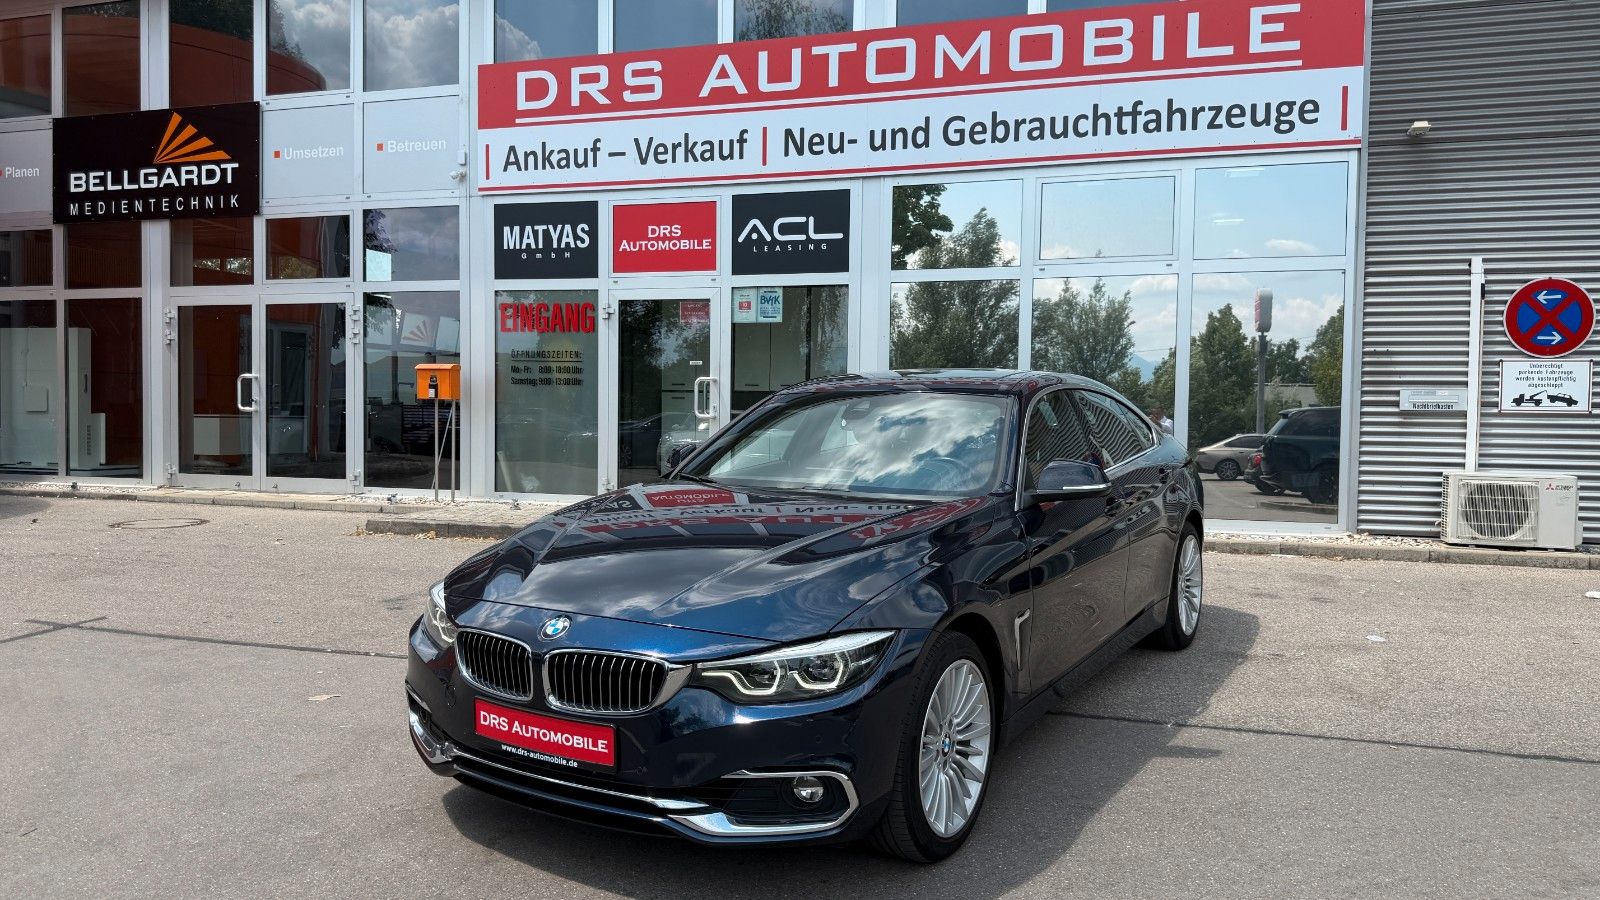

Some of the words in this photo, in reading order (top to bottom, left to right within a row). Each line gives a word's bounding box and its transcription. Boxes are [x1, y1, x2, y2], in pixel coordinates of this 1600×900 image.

[516, 60, 663, 111] DRS
[699, 3, 1301, 98] AUTOMOBILE
[387, 138, 447, 153] Betreuen
[502, 138, 601, 173] Ankauf
[634, 129, 748, 166] Verkauf
[783, 127, 858, 158] Neu-
[869, 116, 930, 152] und
[942, 98, 1320, 147] Gebrauchtfahrzeuge
[284, 145, 344, 160] Umsetzen
[5, 166, 40, 178] Planen
[70, 163, 239, 193] BELLGARDT
[70, 194, 239, 216] MEDIENTECHNIK
[503, 223, 590, 250] MATYAS
[647, 225, 682, 238] DRS
[737, 216, 844, 241] ACL
[619, 238, 712, 252] AUTOMOBILE
[753, 243, 828, 253] LEASING
[500, 302, 595, 334] EINGANG
[480, 711, 509, 732] DRS
[511, 720, 608, 753] AUTOMOBILE
[501, 743, 578, 768] www.drs-automobile.de
